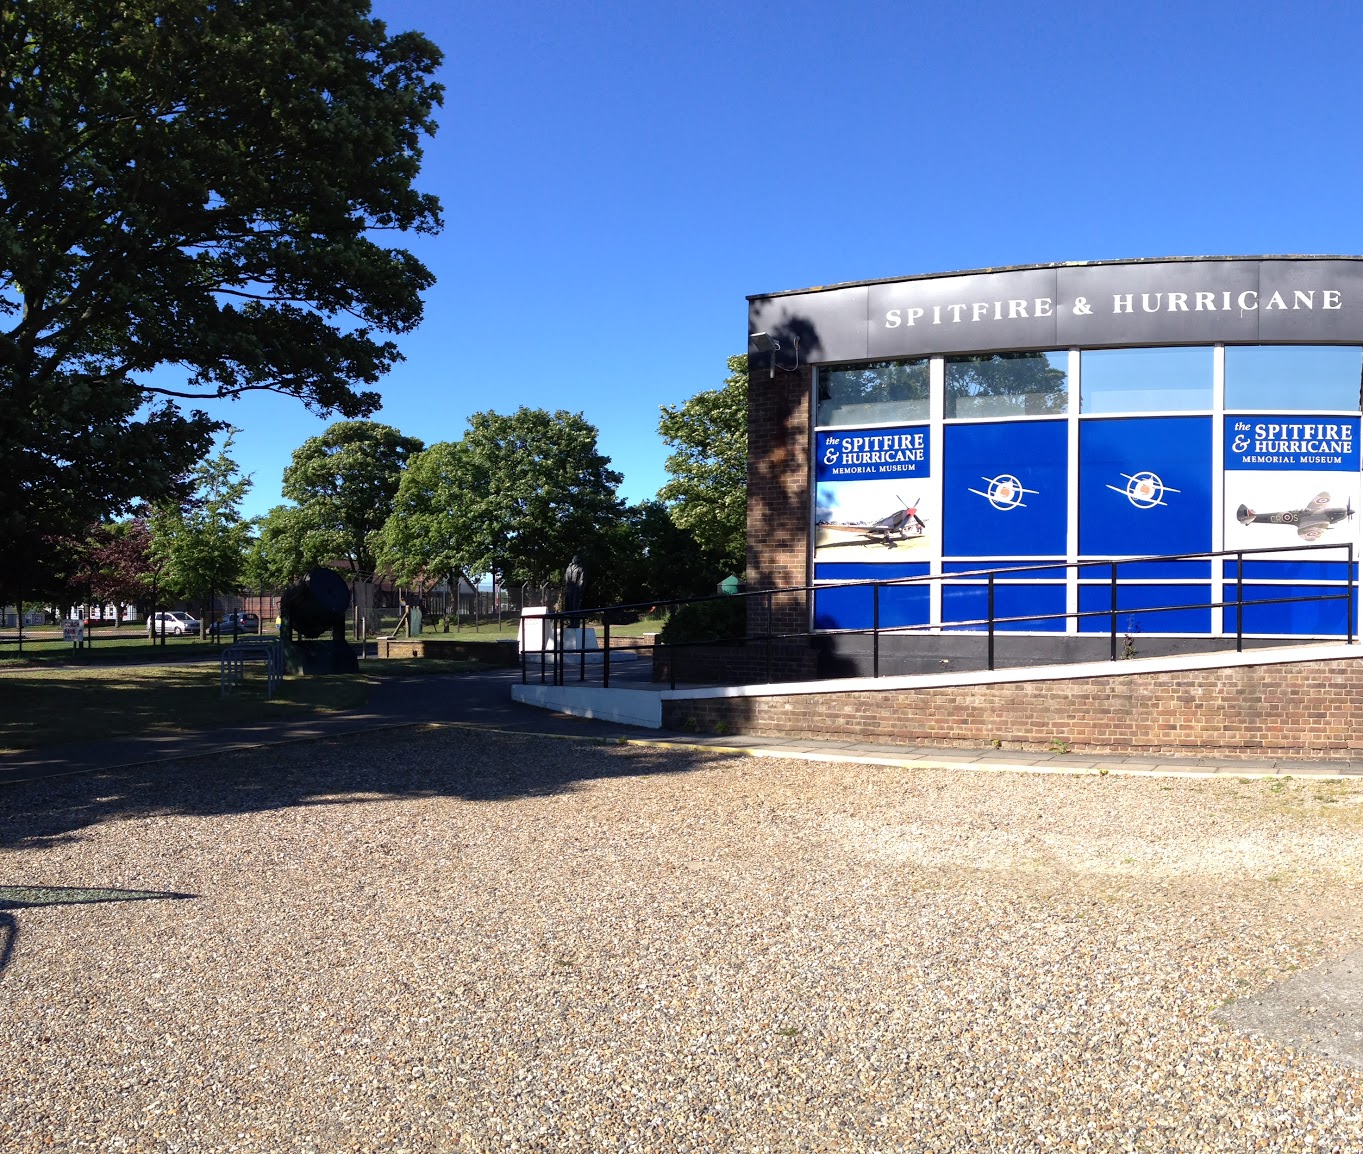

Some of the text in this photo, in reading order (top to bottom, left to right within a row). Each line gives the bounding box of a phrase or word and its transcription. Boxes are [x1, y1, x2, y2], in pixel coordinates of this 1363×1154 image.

[885, 297, 1053, 329] SPITFIRE
[1072, 296, 1093, 316] &
[1112, 290, 1342, 314] HURRICANE
[1234, 422, 1353, 440] the SPITFIRE
[826, 434, 924, 452] the SPITFIRE
[1231, 434, 1353, 454] & HURRICANE
[823, 448, 924, 465] & HURRICANE
[1242, 456, 1343, 465] MEMORIAL MUSEUM
[833, 464, 915, 474] MEMORIAL MUSEUM
